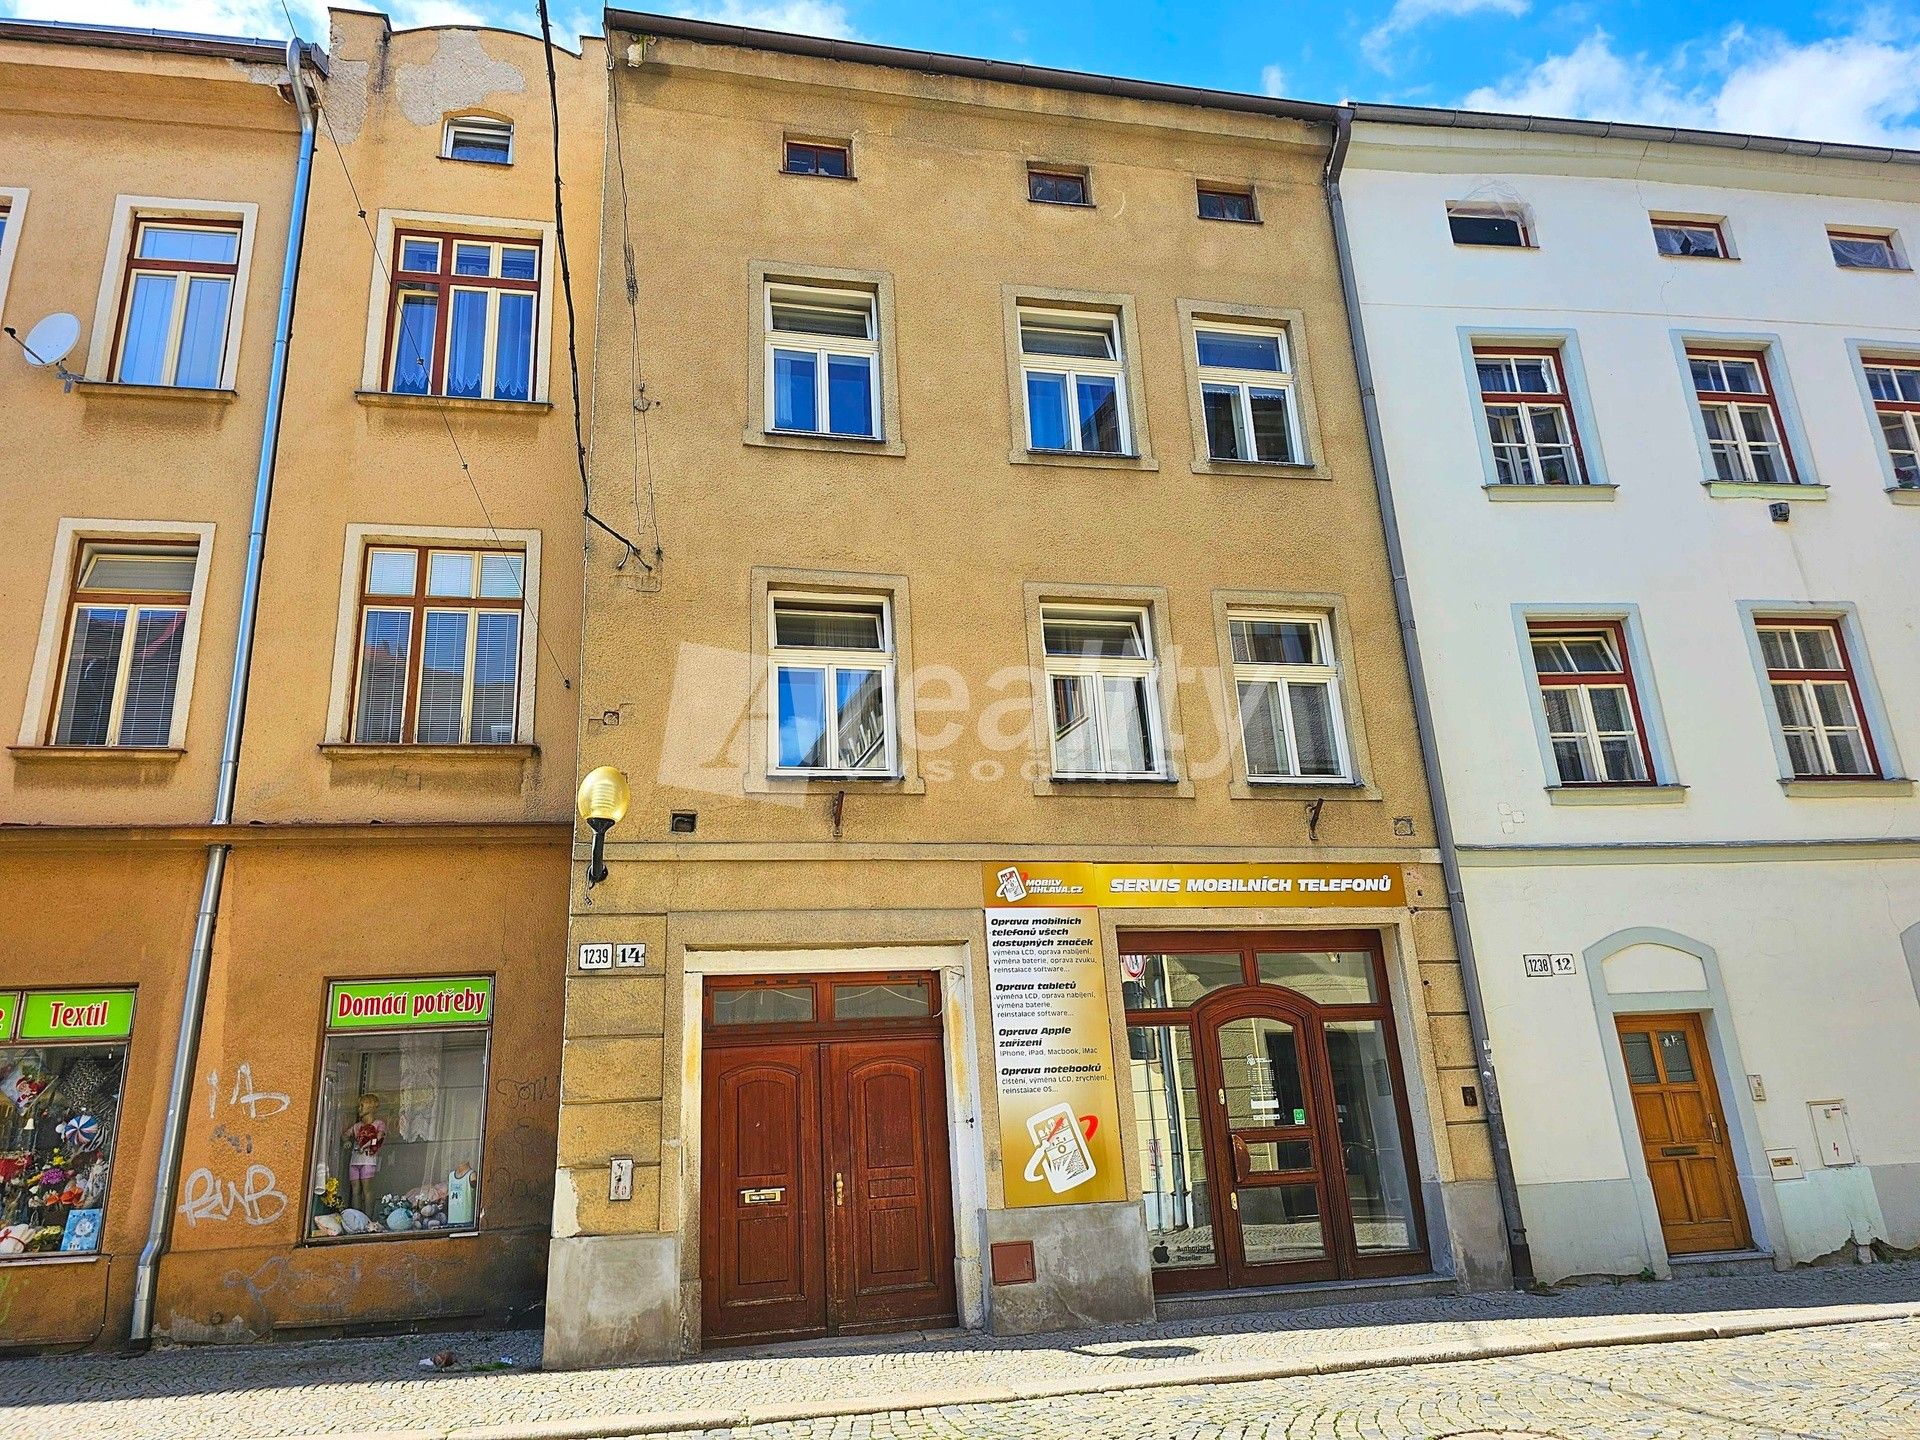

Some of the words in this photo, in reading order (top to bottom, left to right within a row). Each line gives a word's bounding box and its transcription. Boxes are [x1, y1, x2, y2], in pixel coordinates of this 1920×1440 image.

[1025, 879, 1062, 887] MOBILY
[1109, 878, 1180, 892] SERVIS
[1186, 875, 1292, 892] MOBILNÍCH
[1297, 874, 1392, 892] TELEFONŮ
[1028, 886, 1084, 894] JIHLAVA.CZ
[991, 918, 1029, 926] Oprava
[1031, 917, 1081, 925] mobilních
[991, 927, 1037, 936] telefonů
[1039, 927, 1068, 936] všech
[992, 939, 1054, 947] dostupných
[1057, 937, 1093, 946] značek
[583, 948, 609, 964] 1239
[620, 947, 641, 963] 14
[1528, 958, 1549, 972] 1238
[1555, 957, 1572, 971] 12
[995, 983, 1034, 992] Oprava
[1037, 980, 1077, 990] tabletů
[338, 990, 409, 1017] Domácí
[412, 986, 487, 1018] potřeby
[50, 1000, 109, 1028] Textil
[998, 1028, 1038, 1037] Oprava
[1040, 1026, 1071, 1035] Apple
[999, 1037, 1042, 1047] zařízení
[1001, 1067, 1041, 1076] Oprava
[1043, 1063, 1101, 1073] notebooků
[1029, 1076, 1057, 1084] výměna
